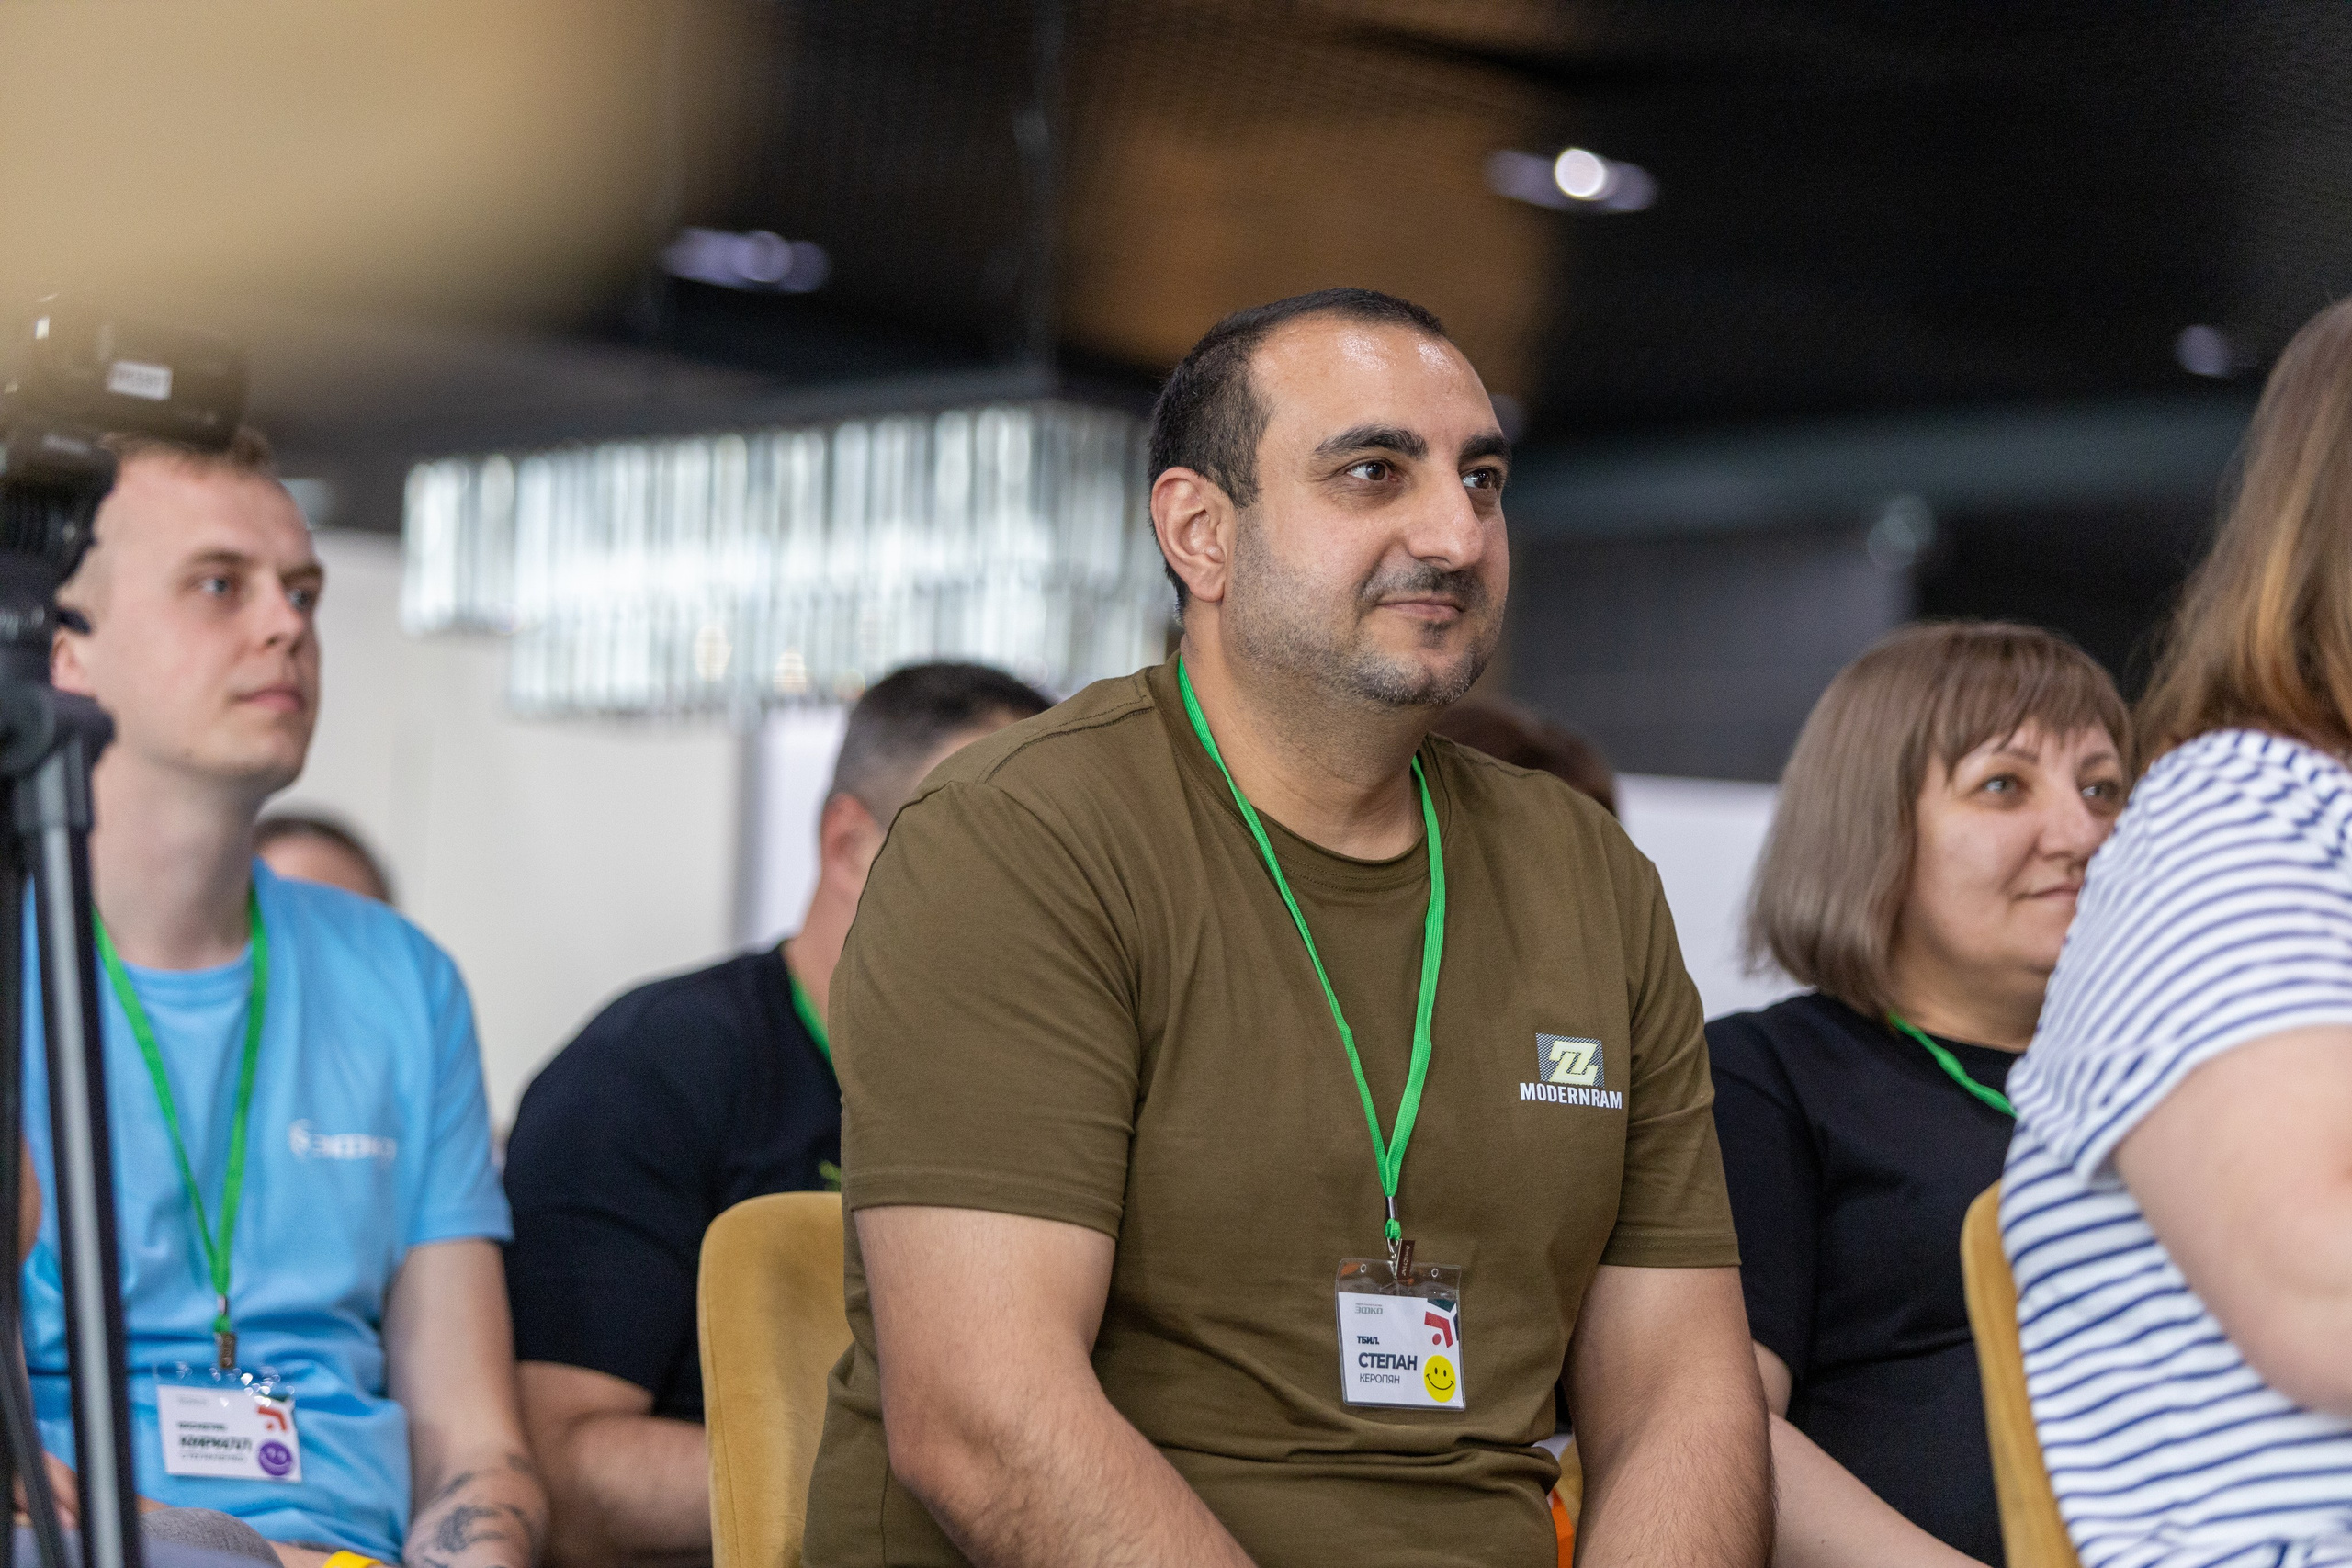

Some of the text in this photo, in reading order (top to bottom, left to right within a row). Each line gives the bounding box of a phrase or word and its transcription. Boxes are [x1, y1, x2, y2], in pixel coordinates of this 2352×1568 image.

[1519, 1082, 1623, 1110] MODERNRAM
[1358, 1351, 1418, 1371] СТЕПАН
[1359, 1373, 1400, 1384] КЕРОПЯН
